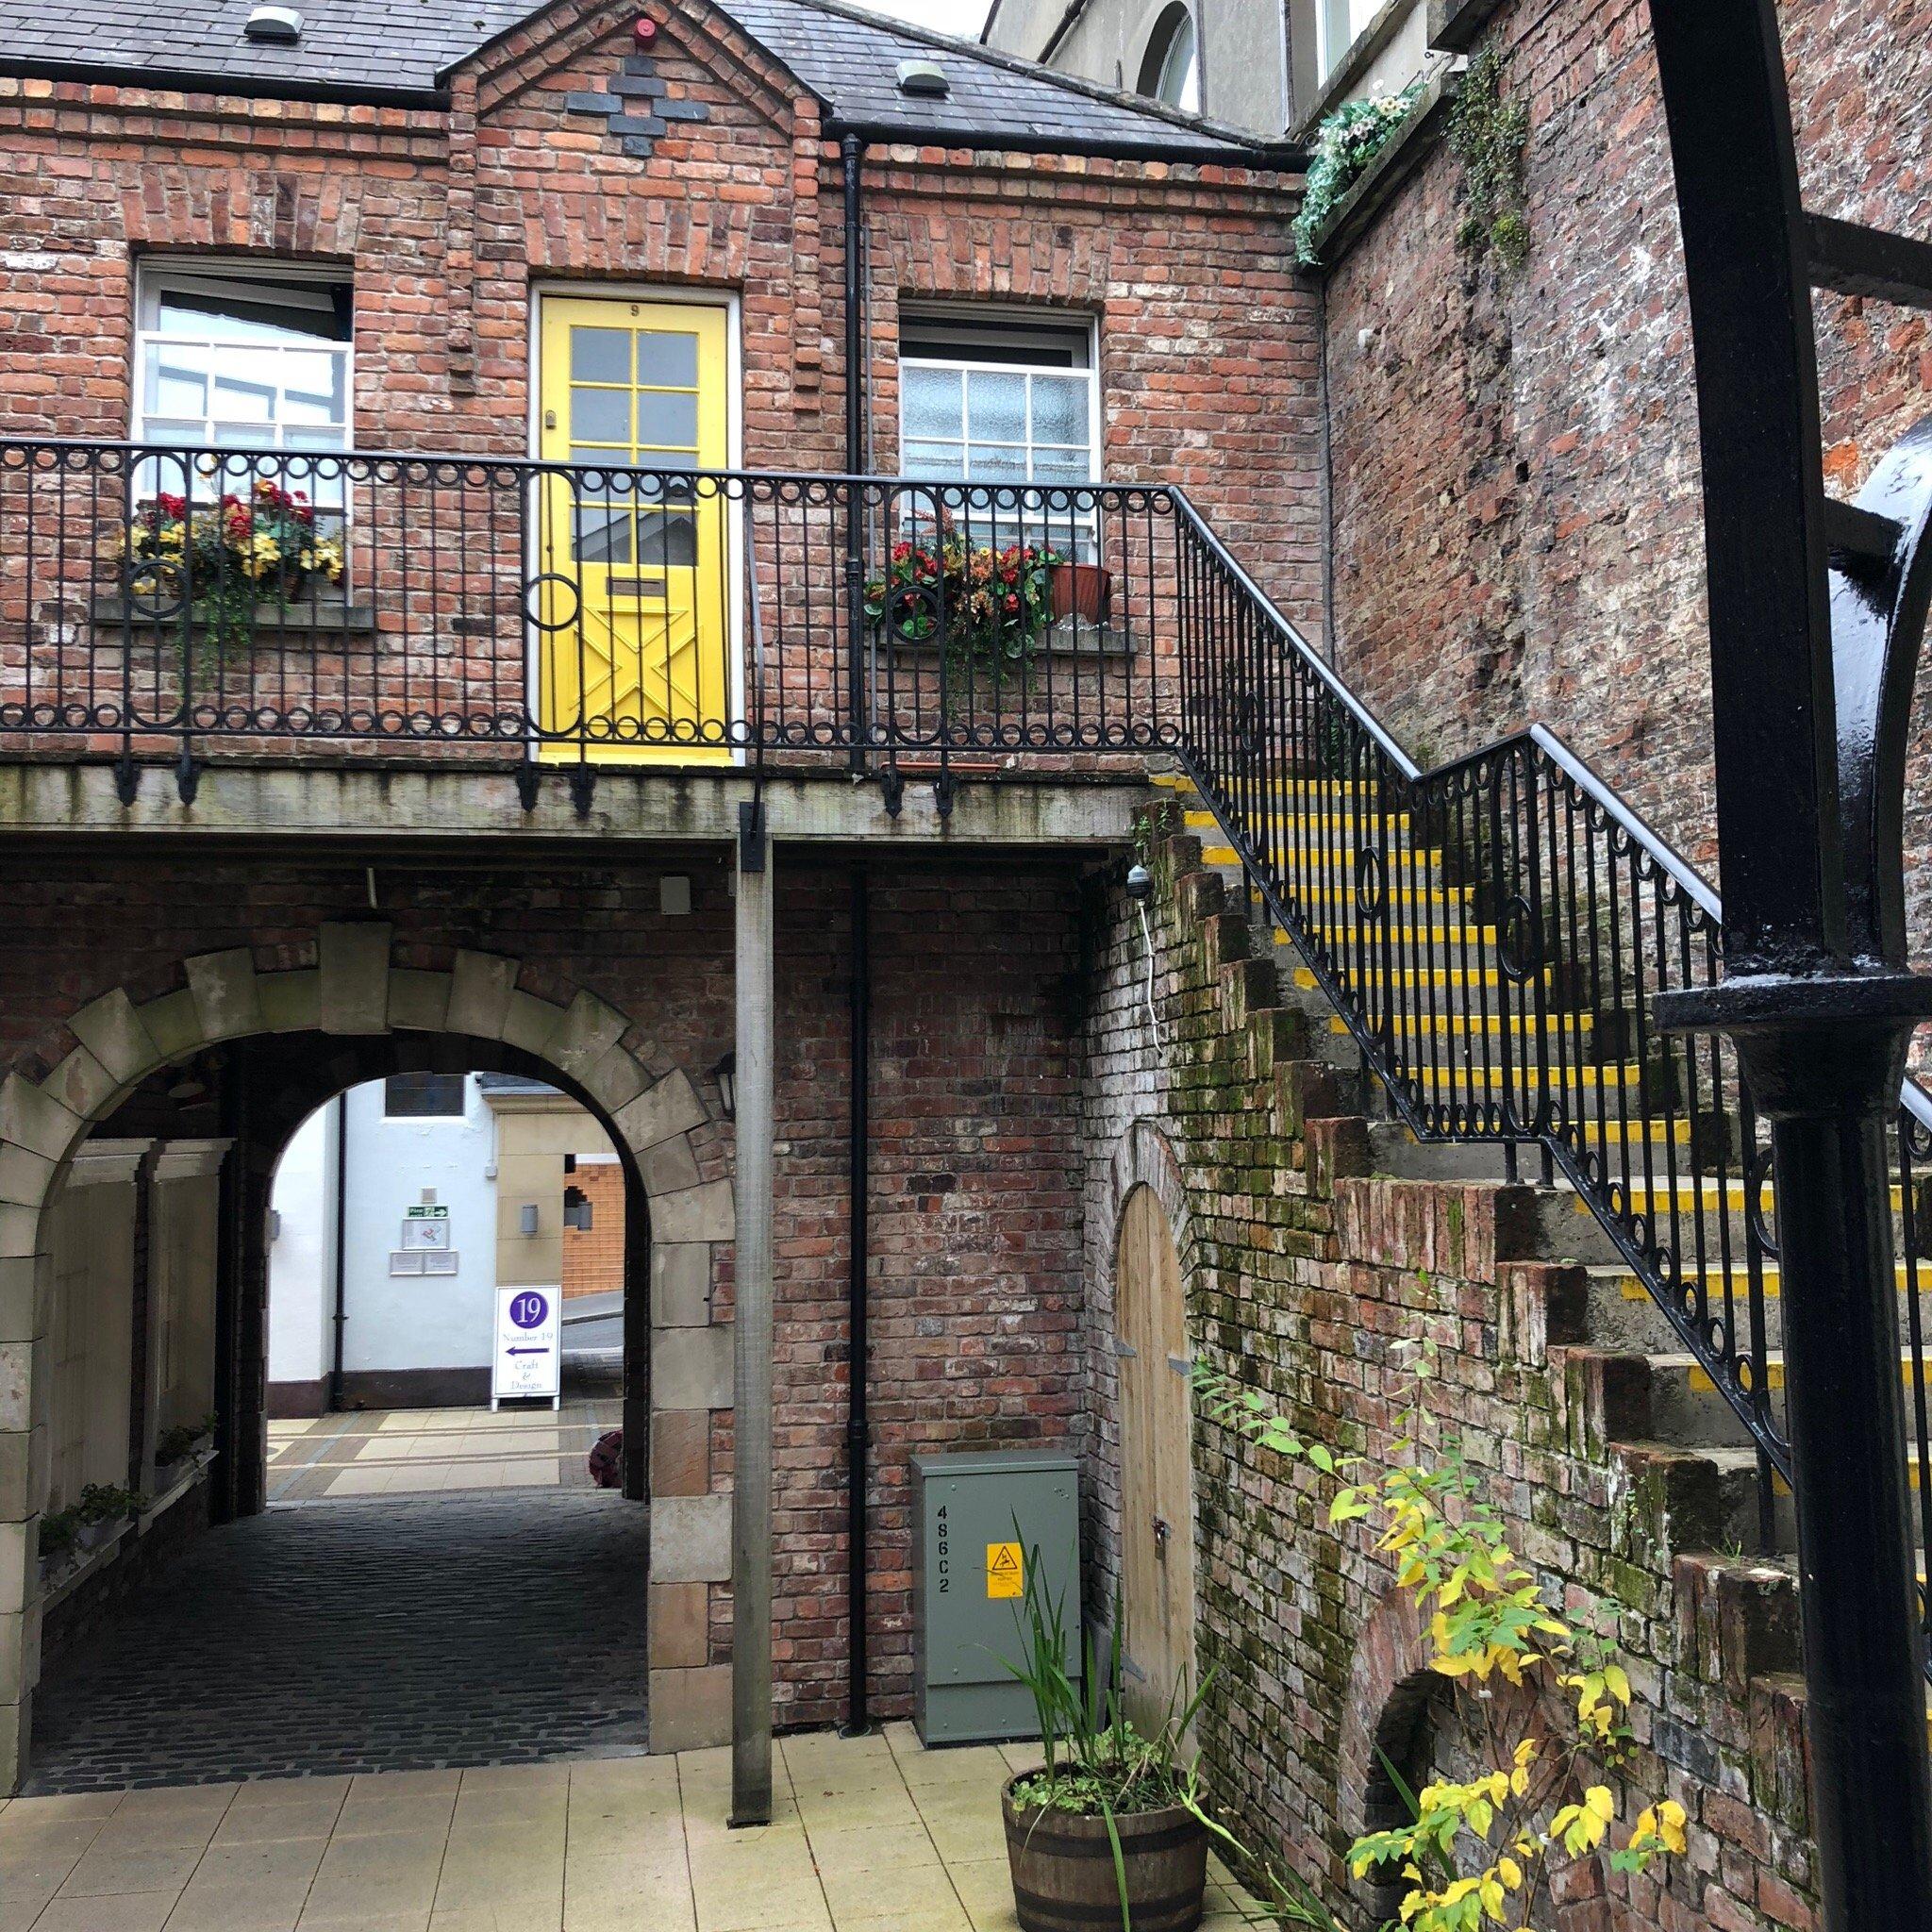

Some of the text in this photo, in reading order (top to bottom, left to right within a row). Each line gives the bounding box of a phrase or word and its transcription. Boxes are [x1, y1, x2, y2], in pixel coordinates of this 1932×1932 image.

[516, 1297, 541, 1324] 19
[503, 1331, 554, 1341] Number 19
[514, 1358, 539, 1370] Craft
[522, 1372, 531, 1381] &
[510, 1380, 542, 1390] Design
